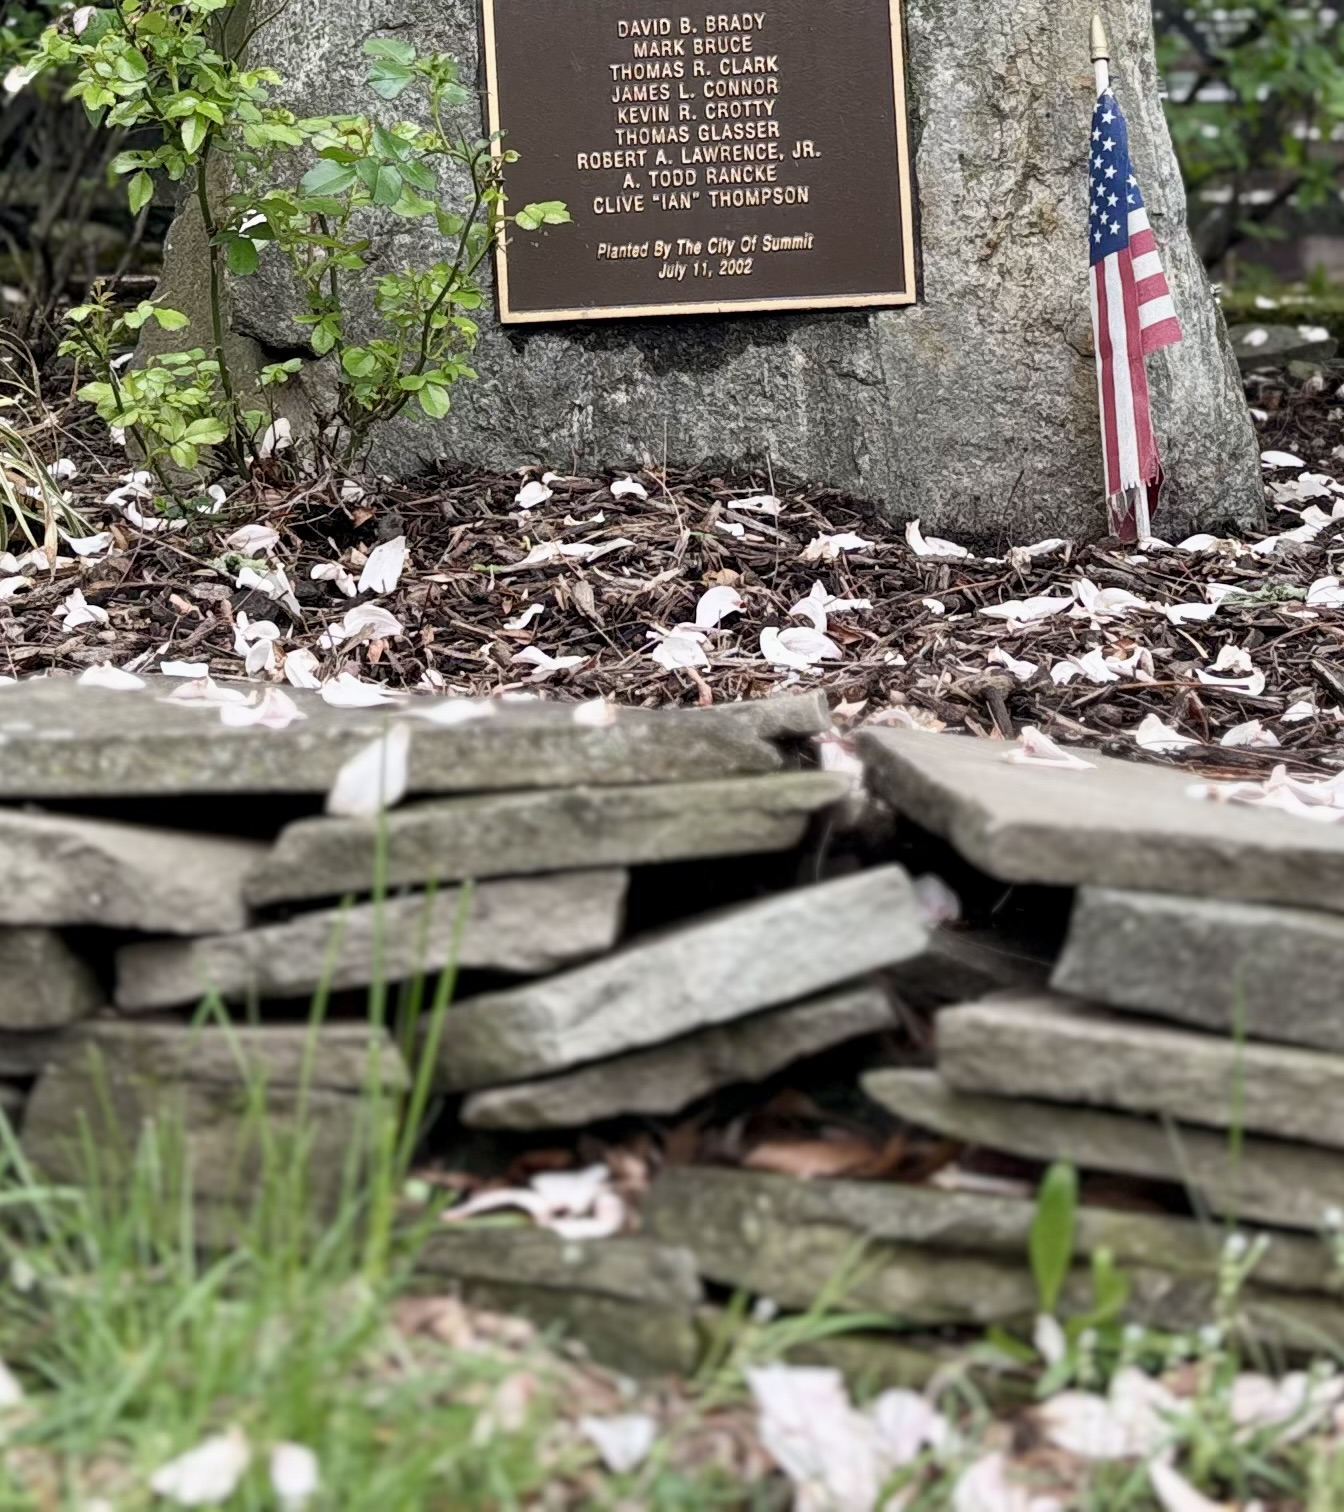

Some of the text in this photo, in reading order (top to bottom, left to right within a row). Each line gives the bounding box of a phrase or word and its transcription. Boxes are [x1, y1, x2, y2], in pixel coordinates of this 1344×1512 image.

[617, 11, 767, 38] DAVID B. BRADY
[633, 34, 753, 58] MARK BRUCE
[609, 54, 780, 81] THOMAS R. CLARK
[611, 76, 779, 103] JAMES L. CONNOR
[617, 98, 777, 124] KEVIN R. CROTTY
[614, 119, 781, 146] THOMAS GLASSER
[576, 139, 822, 170] ROBERT A. LAWRENCE, JR.
[622, 163, 778, 189] A. TODD RANCKE
[593, 194, 645, 215] CLIVE
[707, 185, 810, 208] THOMPSON
[597, 231, 815, 260] Planted By The City Of Summit
[657, 256, 754, 282] July 11, 2002
